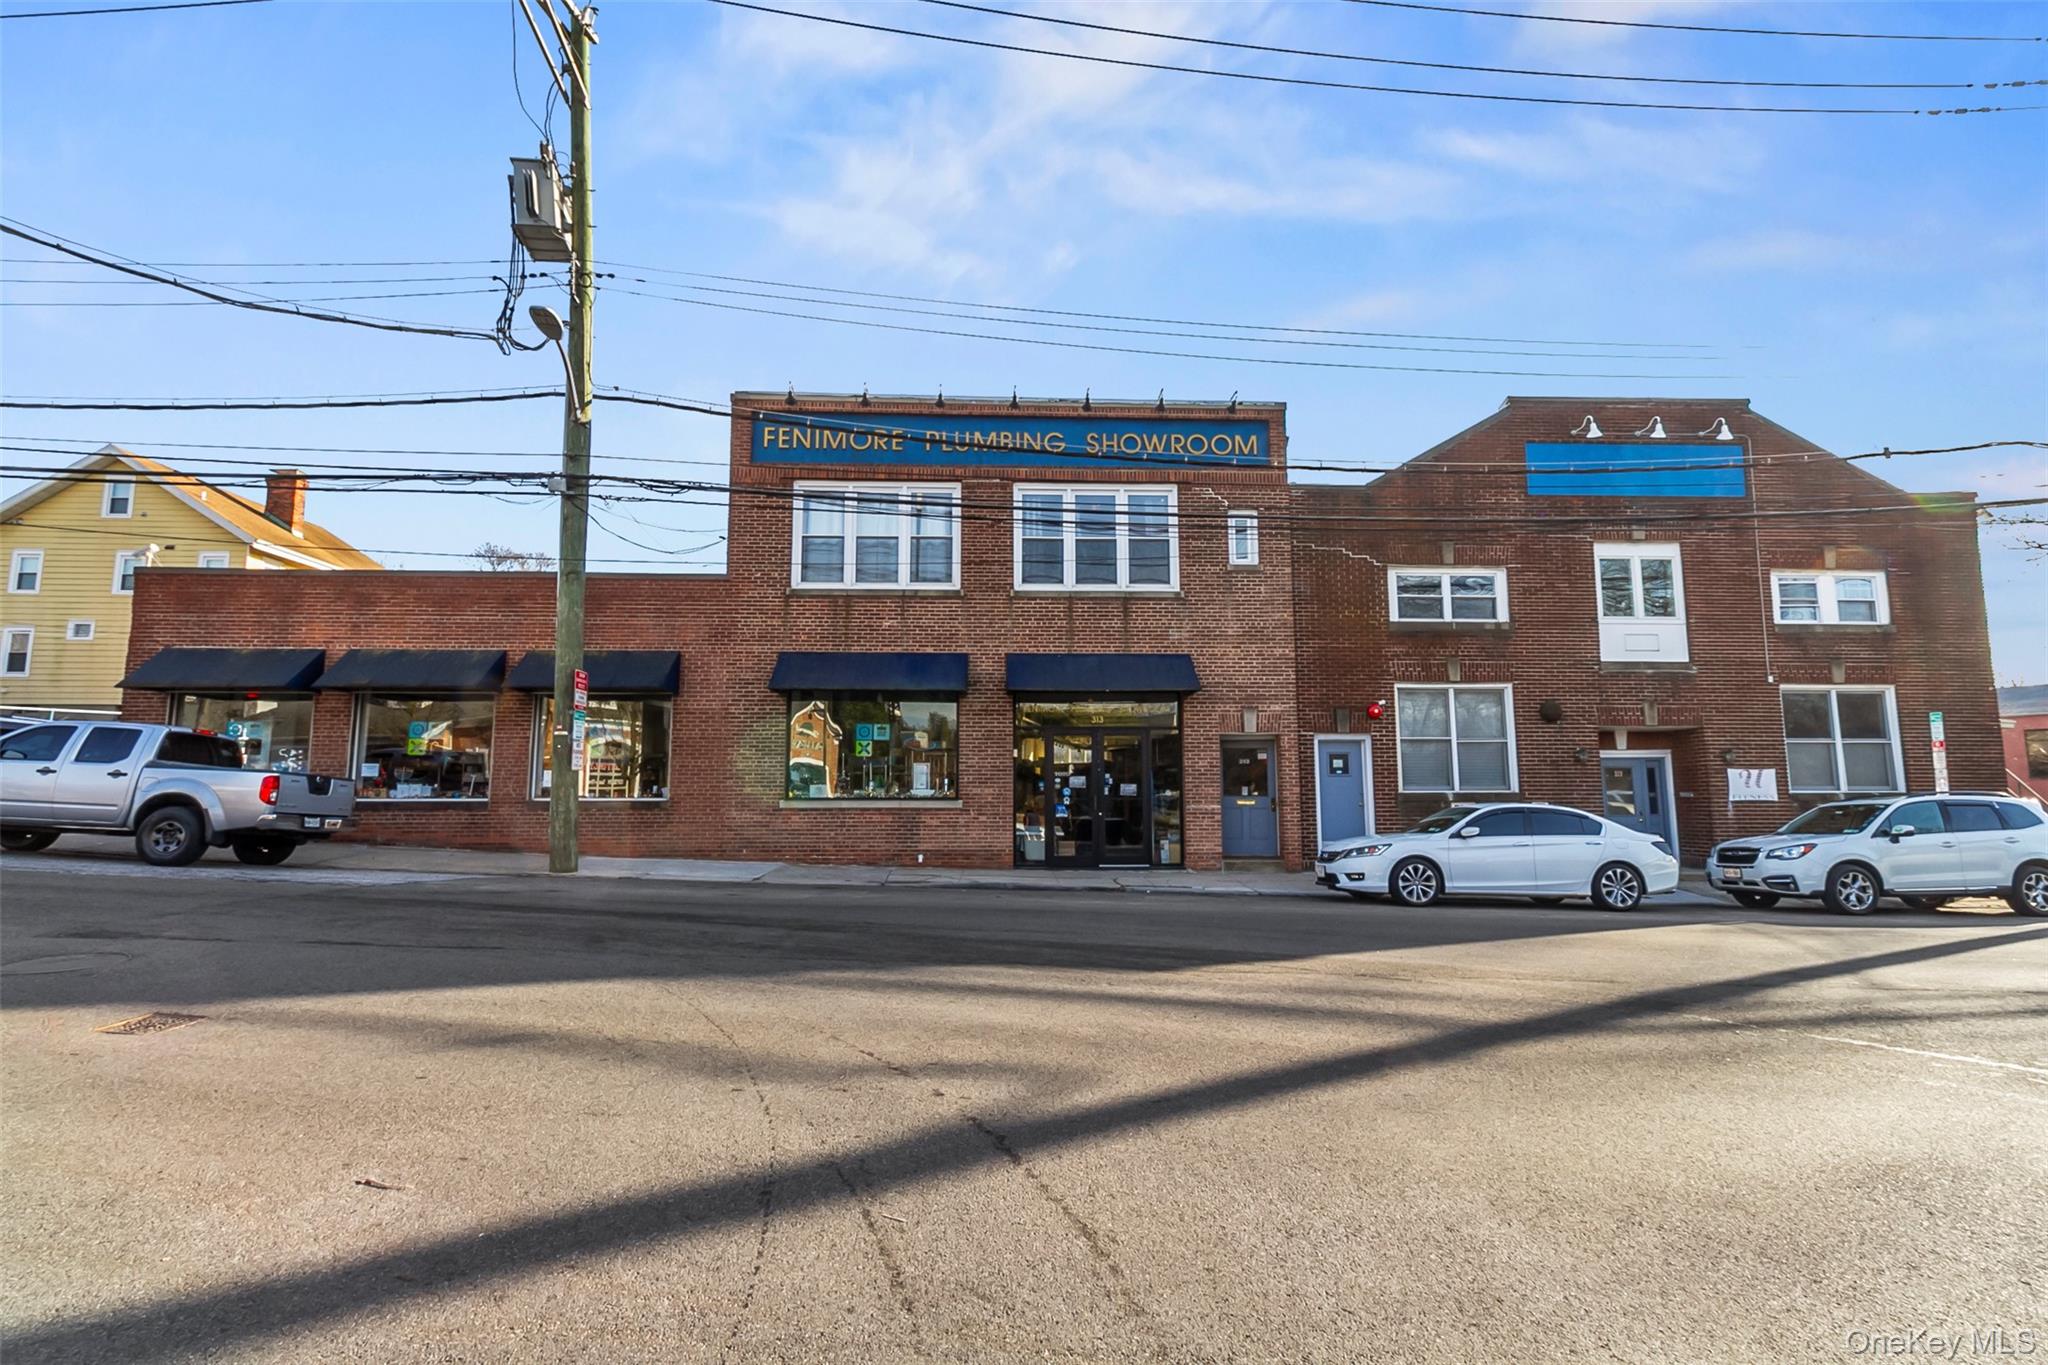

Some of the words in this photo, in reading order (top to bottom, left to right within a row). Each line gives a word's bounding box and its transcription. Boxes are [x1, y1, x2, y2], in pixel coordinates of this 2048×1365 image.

[762, 426, 904, 450] FENIMORE
[925, 430, 1067, 454] PLUMBING
[1086, 432, 1258, 455] SHOWROOM
